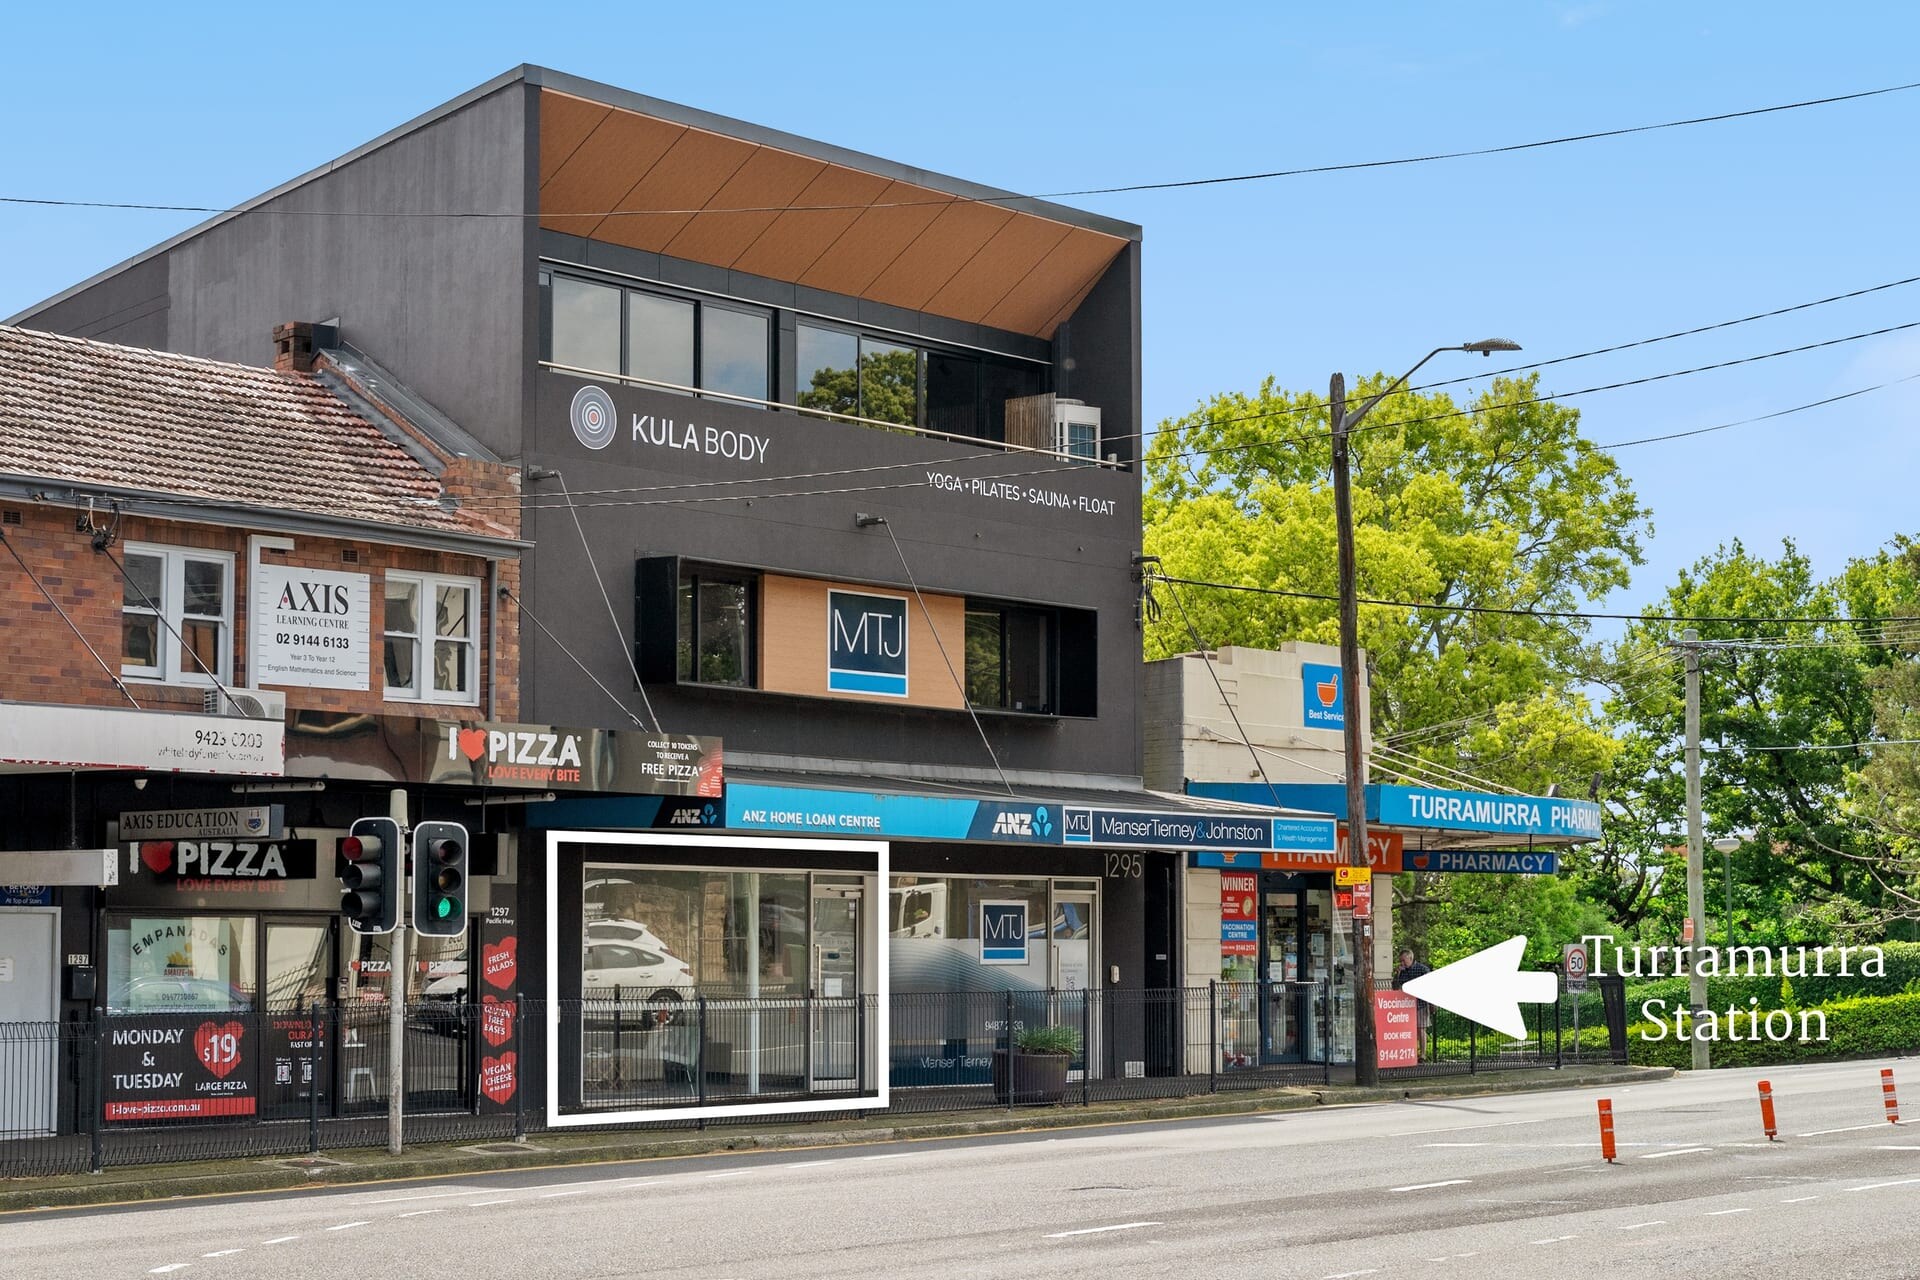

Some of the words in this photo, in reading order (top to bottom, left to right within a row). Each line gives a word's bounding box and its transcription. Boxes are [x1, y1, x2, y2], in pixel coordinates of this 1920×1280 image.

[632, 414, 699, 453] KULA
[706, 427, 770, 464] BODY
[926, 470, 962, 492] YOGA
[971, 478, 1020, 502] PILATES
[1028, 488, 1070, 509] SAUNA
[1078, 494, 1116, 516] FLOAT
[277, 580, 349, 616] AXIS
[276, 615, 317, 628] LEARNING
[319, 618, 349, 630] CENTRE
[276, 632, 290, 645] 02
[294, 634, 320, 647] 9144
[323, 636, 349, 649] 6133
[833, 609, 904, 659] MTJ
[290, 653, 302, 662] Year
[268, 664, 288, 673] English
[290, 666, 323, 675] Mathematics
[336, 669, 357, 677] Science
[1308, 709, 1324, 720] Best
[448, 727, 458, 761] I
[489, 732, 581, 767] PIZZA
[648, 740, 670, 750] COLLECT
[488, 766, 518, 780] LOVE
[520, 768, 556, 782] EVERY
[557, 770, 580, 783] BITE
[642, 763, 665, 775] FREE
[670, 809, 702, 825] ANZ
[1408, 794, 1541, 827] TURRAMURRA
[124, 814, 154, 830] AXIS
[157, 811, 239, 829] EDUCATION
[742, 810, 766, 823] ANZ
[770, 811, 803, 826] HOME
[806, 813, 836, 827] LOAN
[839, 814, 881, 829] CENTRE
[992, 812, 1033, 836] ANZ
[1066, 814, 1091, 832] MTJ
[198, 828, 239, 837] AUSTRALIA
[1300, 825, 1329, 833] Accountants
[130, 842, 139, 874] I
[178, 842, 287, 877] PIZZA
[1104, 852, 1142, 879] 1295
[1440, 854, 1547, 871] PHARMACY
[176, 878, 211, 892] LOVE
[214, 879, 255, 892] EVERY
[258, 879, 286, 893] BITE
[1222, 877, 1255, 892] WINNER
[490, 908, 510, 917] 1297
[486, 917, 504, 925] Pacific
[504, 918, 514, 926] Hwy
[985, 914, 1024, 940] MTJ
[70, 955, 88, 964] 1297
[488, 952, 510, 964] FRESH
[1571, 958, 1583, 970] 50
[360, 961, 392, 972] PIZZA
[486, 960, 515, 976] SALADS
[1378, 998, 1416, 1009] Vaccination
[488, 1014, 505, 1026] FREE
[1387, 1012, 1410, 1023] Centre
[112, 1029, 184, 1045] MONDAY
[288, 1031, 307, 1040] OUR
[307, 1031, 324, 1040] AP
[1384, 1032, 1398, 1040] BOOK
[1400, 1032, 1412, 1040] HERE
[204, 1034, 237, 1064] $19
[1380, 1050, 1398, 1061] 9144
[1399, 1048, 1416, 1060] 2174
[142, 1052, 156, 1067] &
[922, 1056, 957, 1069] Manser
[960, 1056, 993, 1069] Tierney
[484, 1064, 512, 1076] VEGAN
[112, 1072, 183, 1090] TUESDAY
[196, 1082, 222, 1091] LARGE
[224, 1081, 248, 1091] PIZZA
[485, 1073, 513, 1087] CHEESE
[112, 1102, 201, 1115] i-love-pizza.com.au
